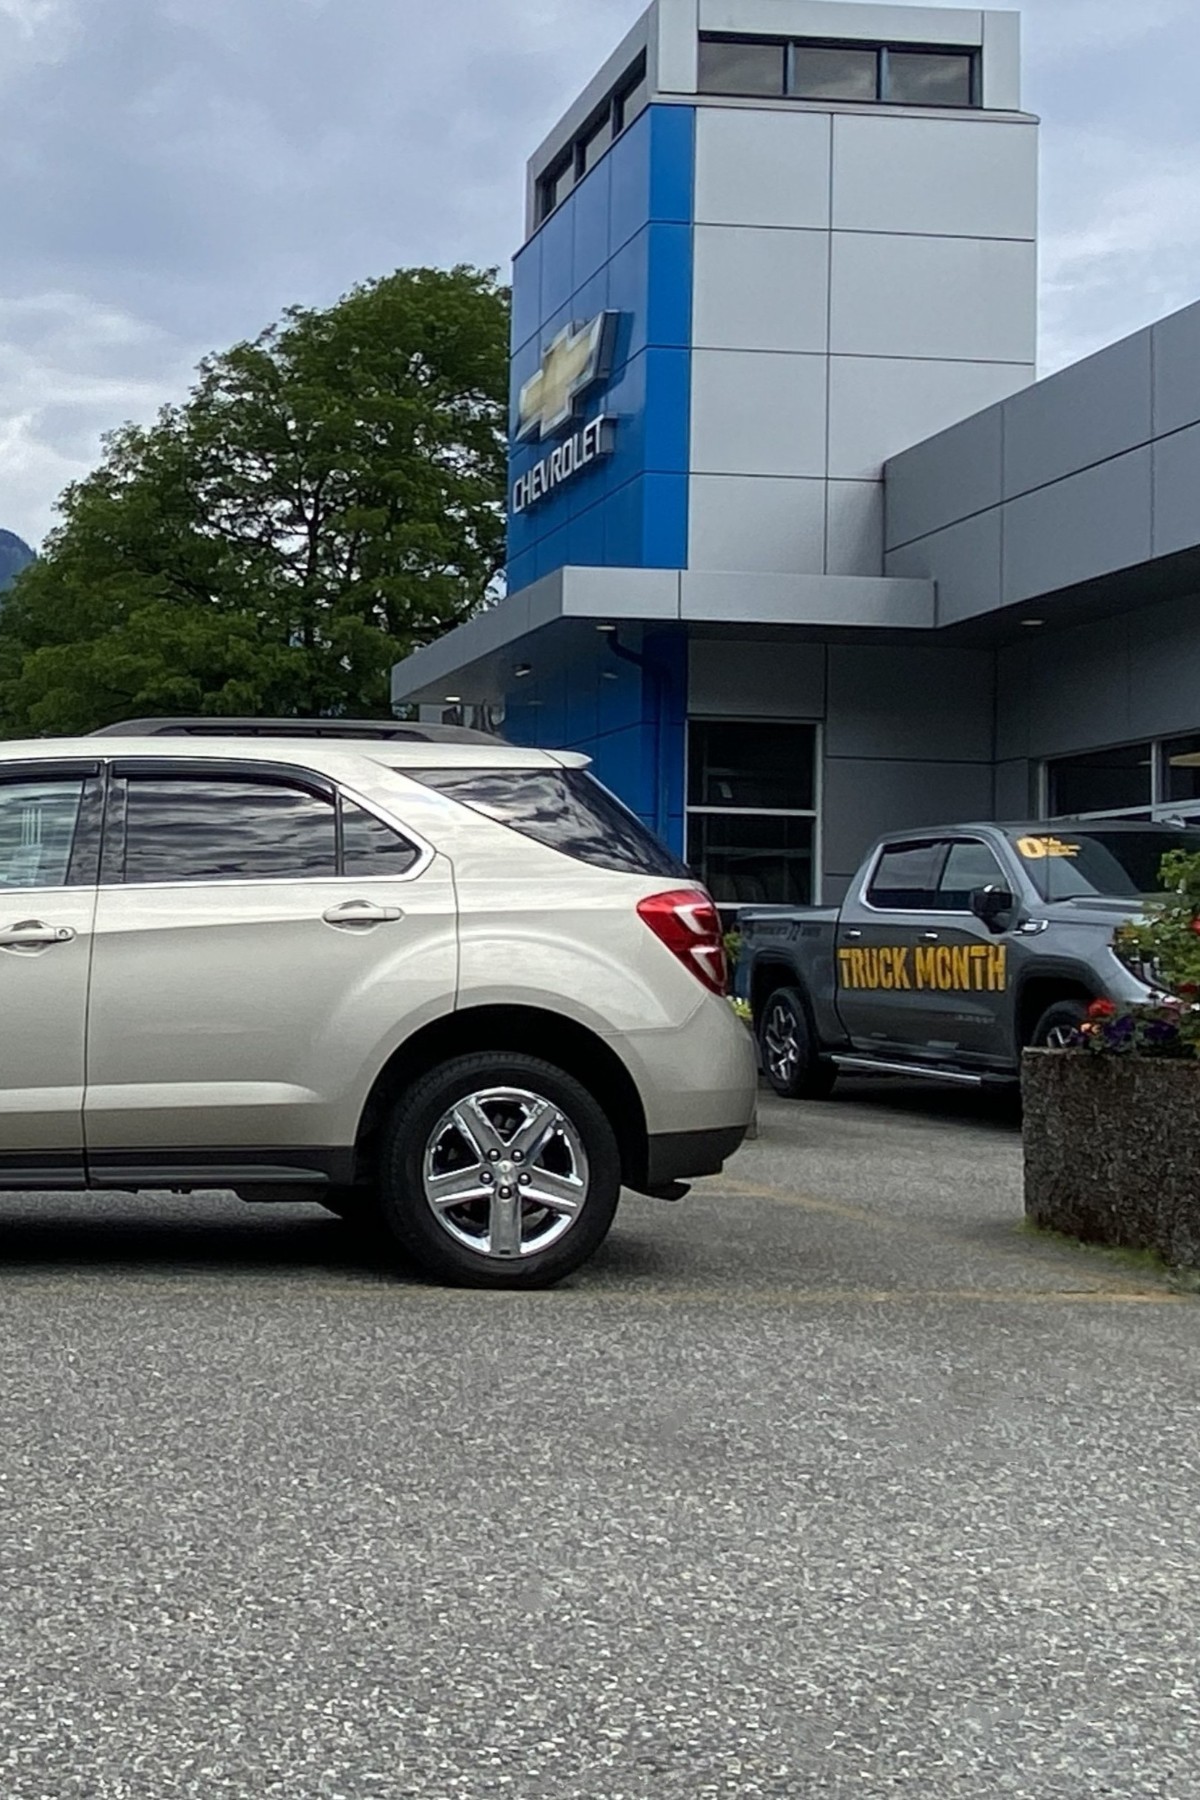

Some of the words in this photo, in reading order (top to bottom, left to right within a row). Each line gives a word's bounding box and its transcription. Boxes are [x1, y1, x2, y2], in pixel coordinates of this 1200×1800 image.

[512, 413, 605, 514] CHEVROLET
[838, 946, 912, 990] TRUCK
[914, 944, 1007, 992] MONTH
